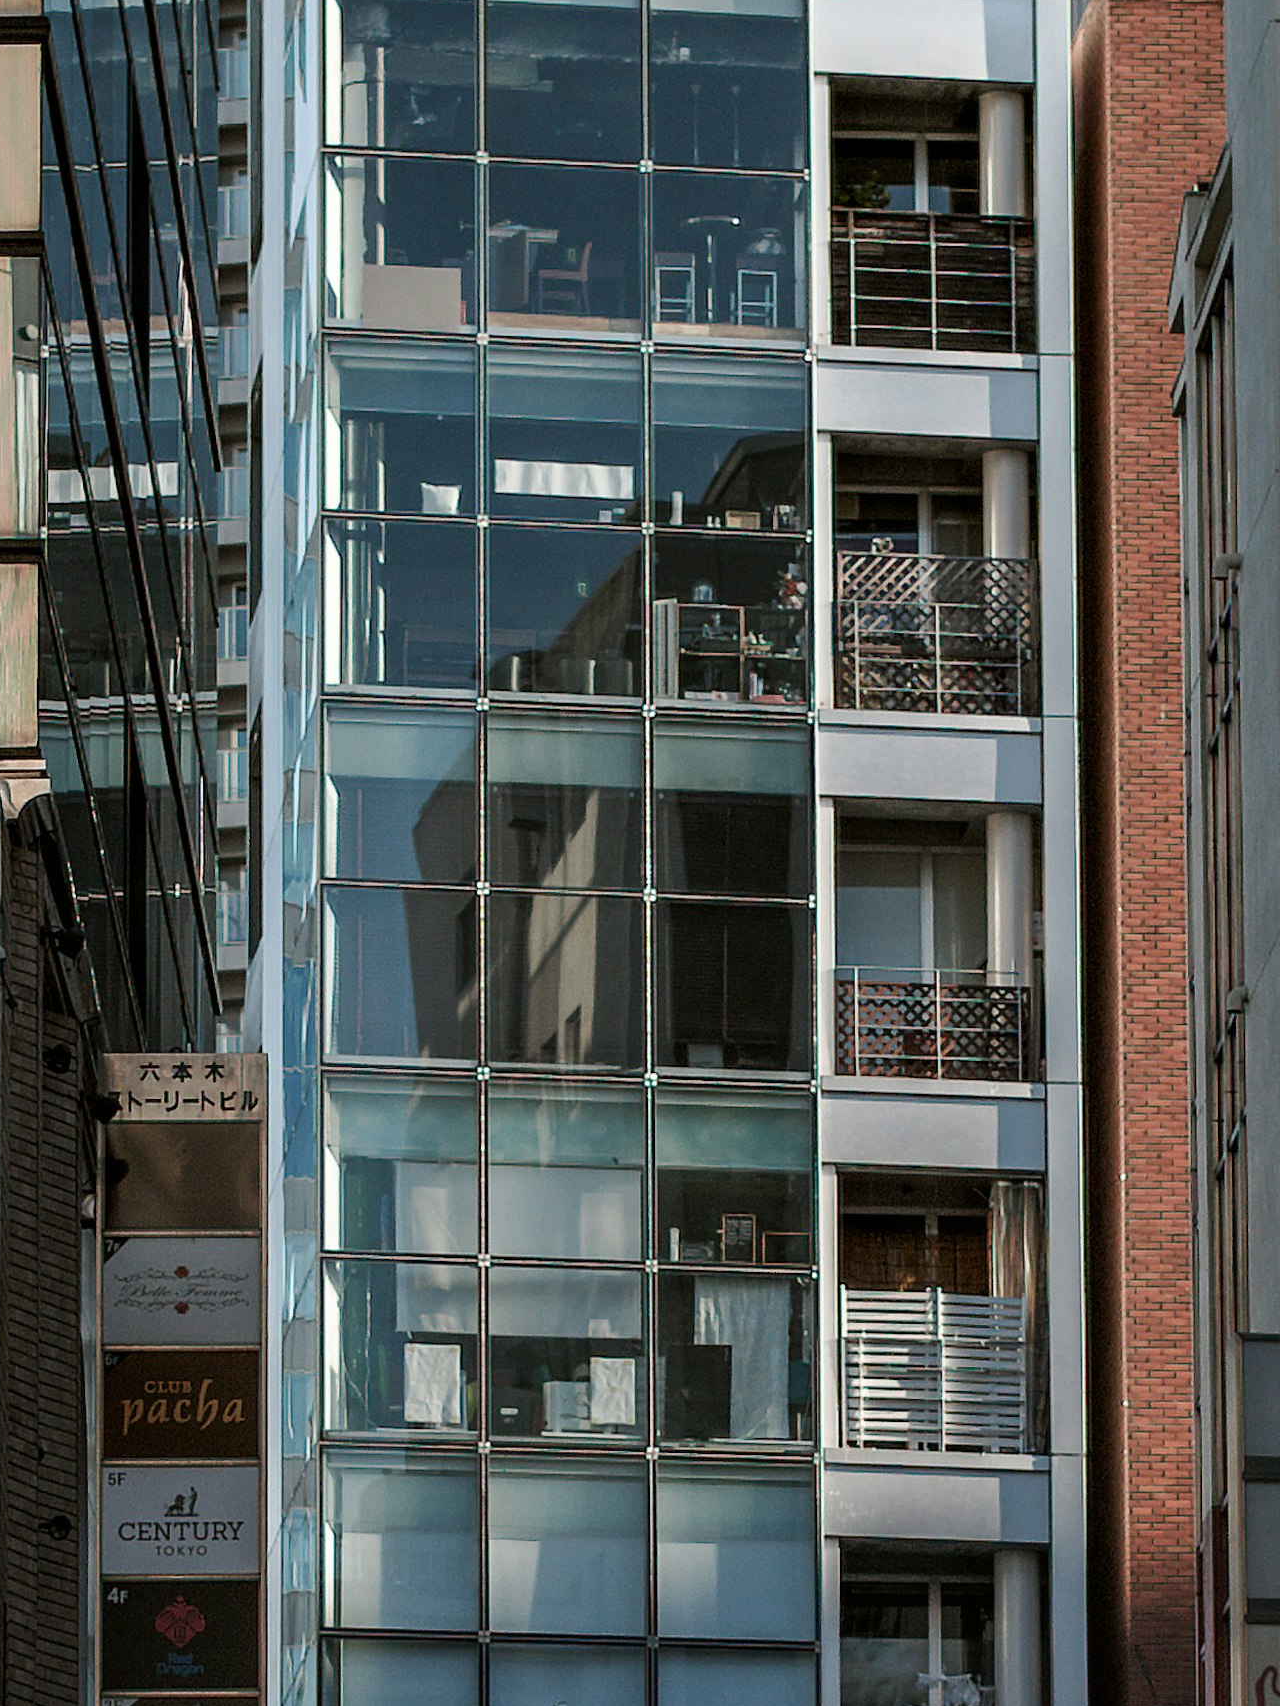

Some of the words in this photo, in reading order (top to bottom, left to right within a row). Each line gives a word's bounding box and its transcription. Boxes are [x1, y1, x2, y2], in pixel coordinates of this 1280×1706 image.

[139, 1061, 225, 1083] 六本木
[144, 1380, 193, 1394] CLUB
[122, 1378, 246, 1436] pacha
[107, 1472, 126, 1486] 5F
[118, 1521, 244, 1541] CENTURY
[156, 1545, 208, 1556] TOKYO
[106, 1586, 130, 1605] 4F
